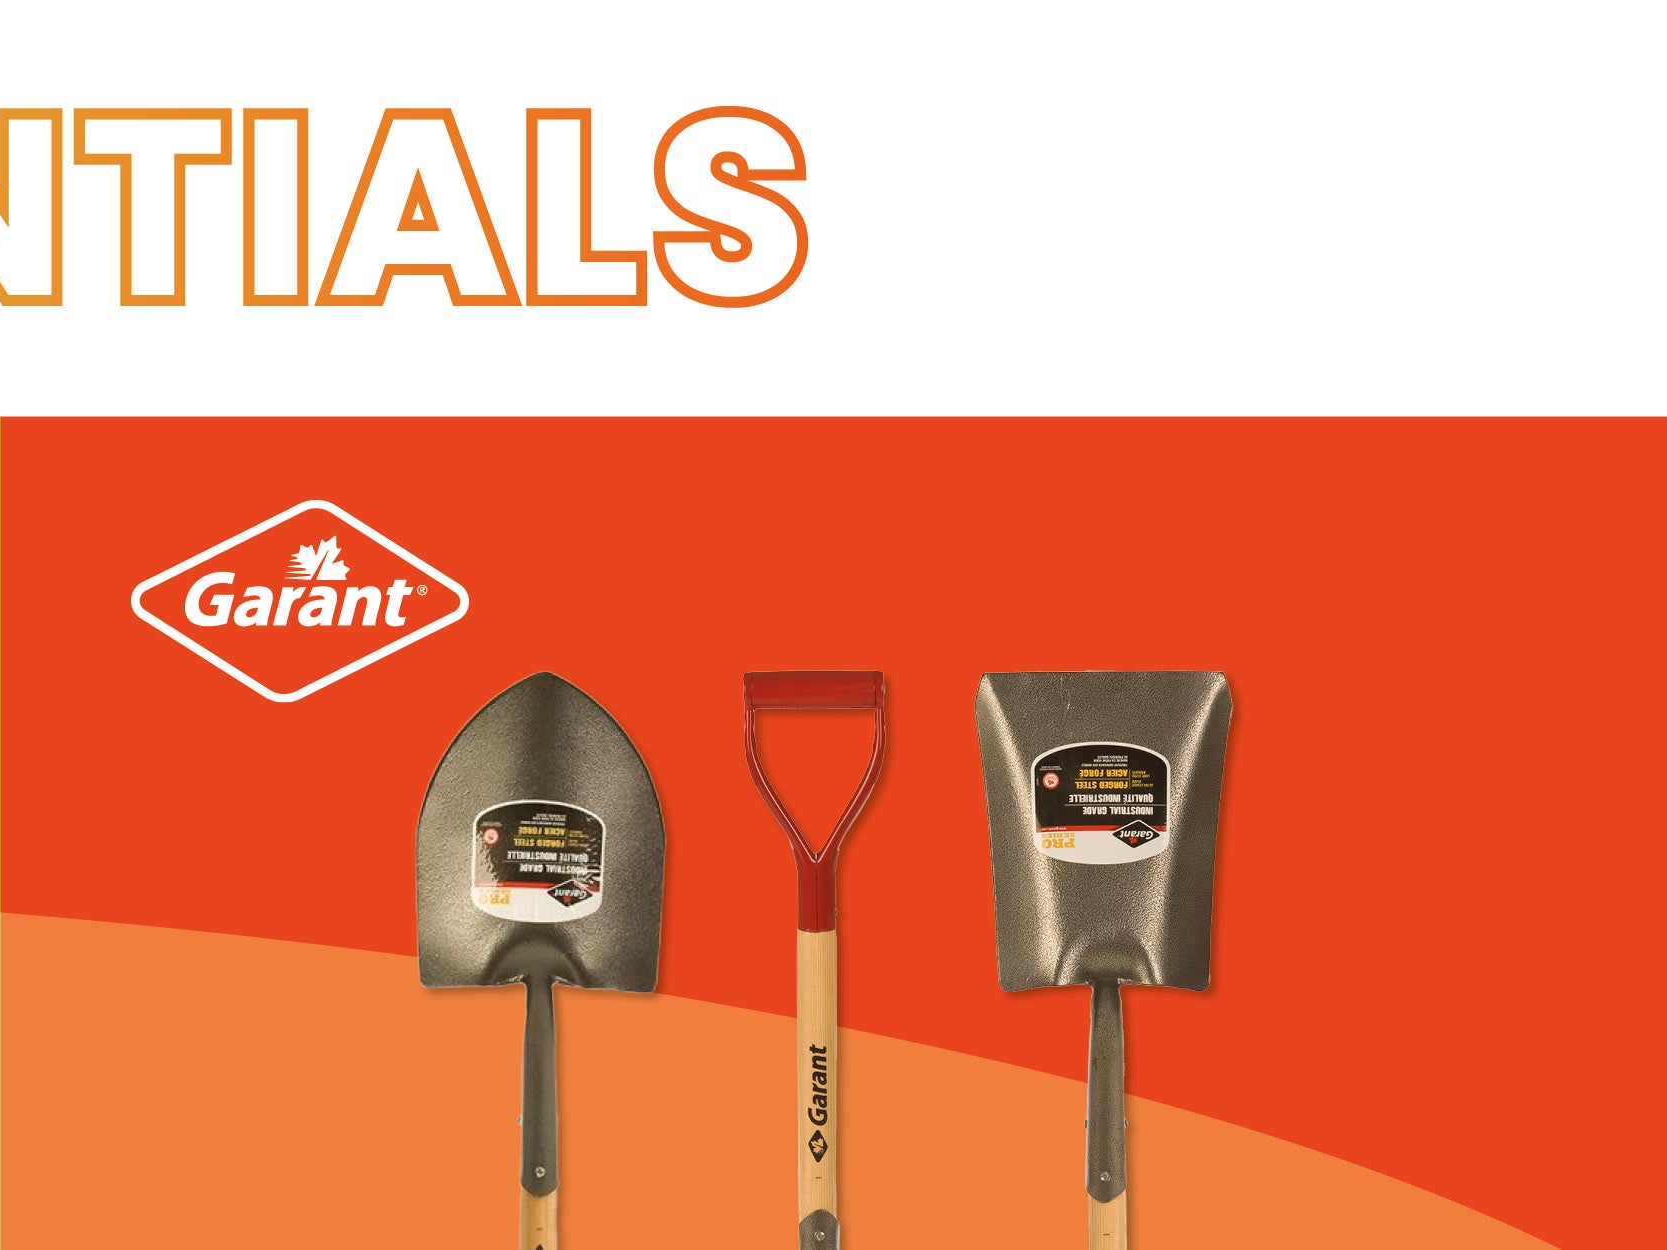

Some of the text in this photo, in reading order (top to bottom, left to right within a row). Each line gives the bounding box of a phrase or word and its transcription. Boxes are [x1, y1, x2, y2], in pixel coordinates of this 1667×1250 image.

[1106, 769, 1128, 777] ACIER
[1075, 781, 1097, 789] STEEL
[1099, 781, 1128, 789] FORGED
[1068, 794, 1122, 803] INDUSTRIELLE
[1082, 806, 1154, 815] INDUSTRIAL GRADE
[1119, 830, 1154, 840] Garant
[1041, 838, 1075, 849] PRO
[807, 1044, 828, 1126] Garant
